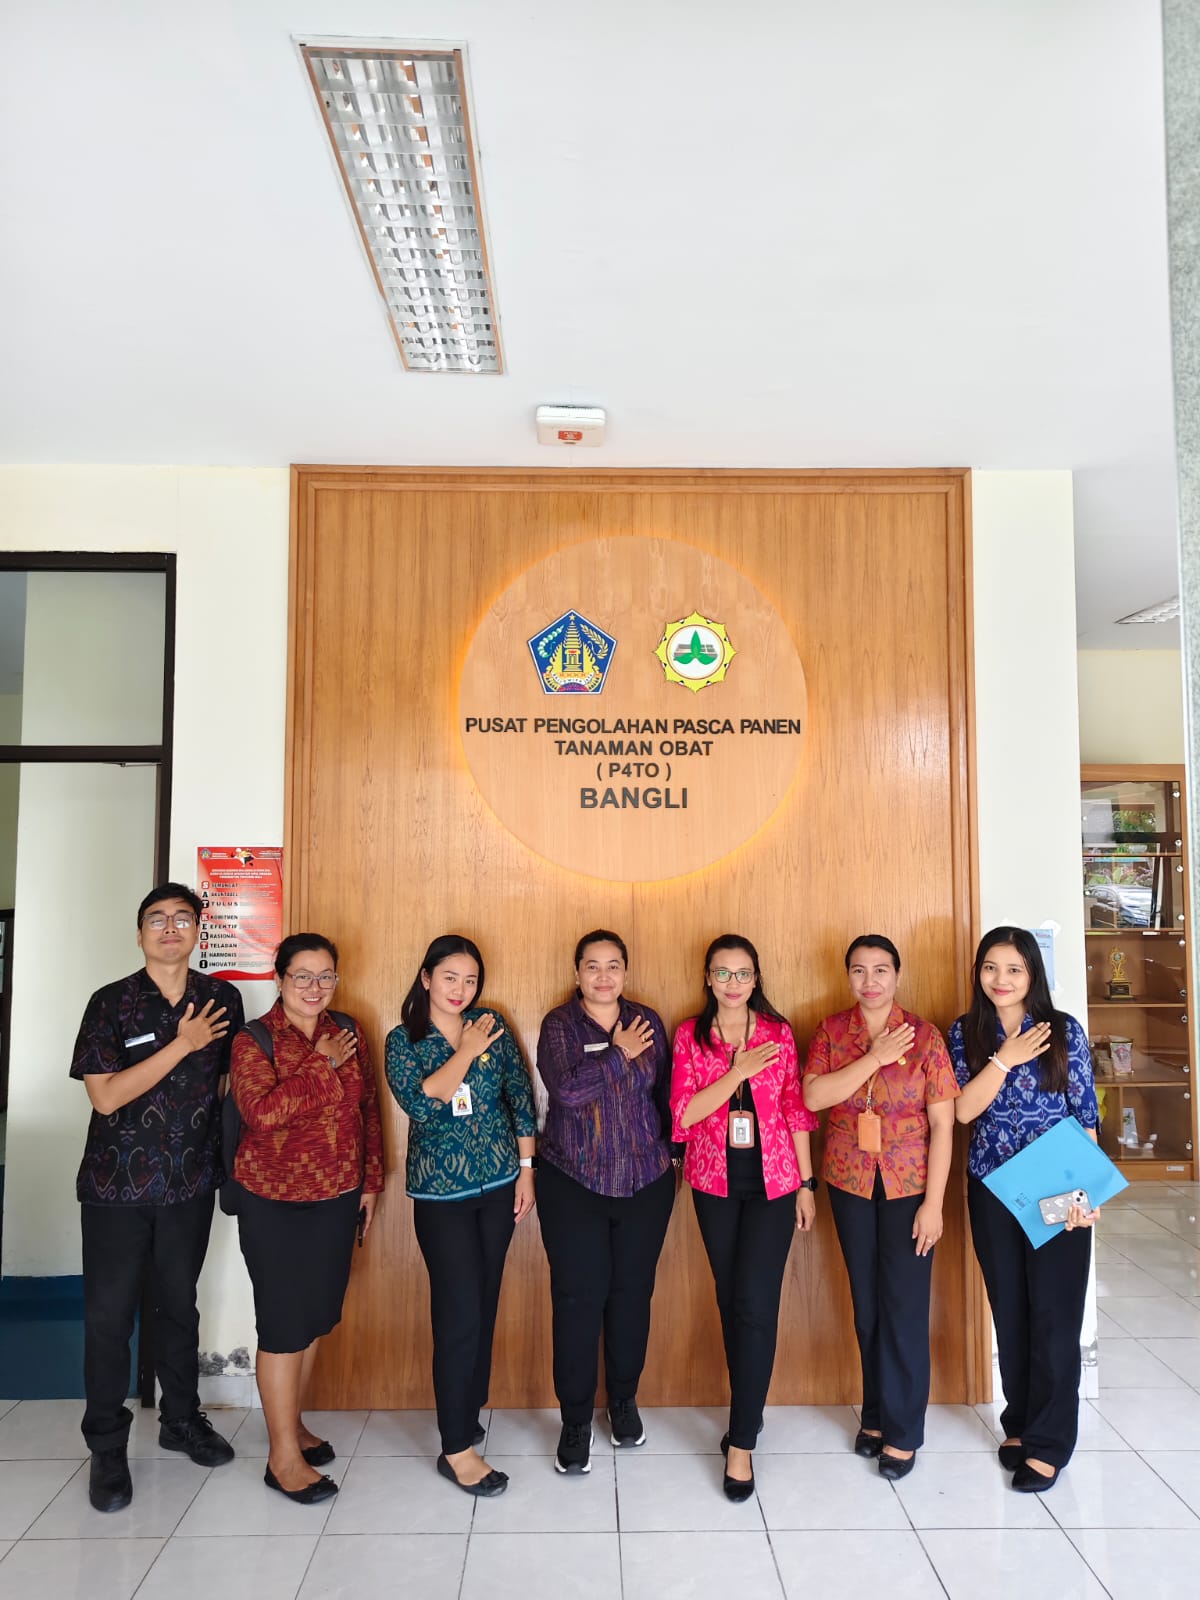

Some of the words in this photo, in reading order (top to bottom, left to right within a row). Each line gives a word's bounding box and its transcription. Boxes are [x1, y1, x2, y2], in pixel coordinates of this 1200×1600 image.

[465, 718, 527, 733] PUSAT
[534, 718, 668, 734] PENGOLAHAN
[673, 719, 735, 735] PASCA
[740, 719, 801, 734] PANEN
[555, 740, 652, 755] TANAMAN
[659, 740, 714, 756] OBAT
[580, 787, 688, 808] BANGLI
